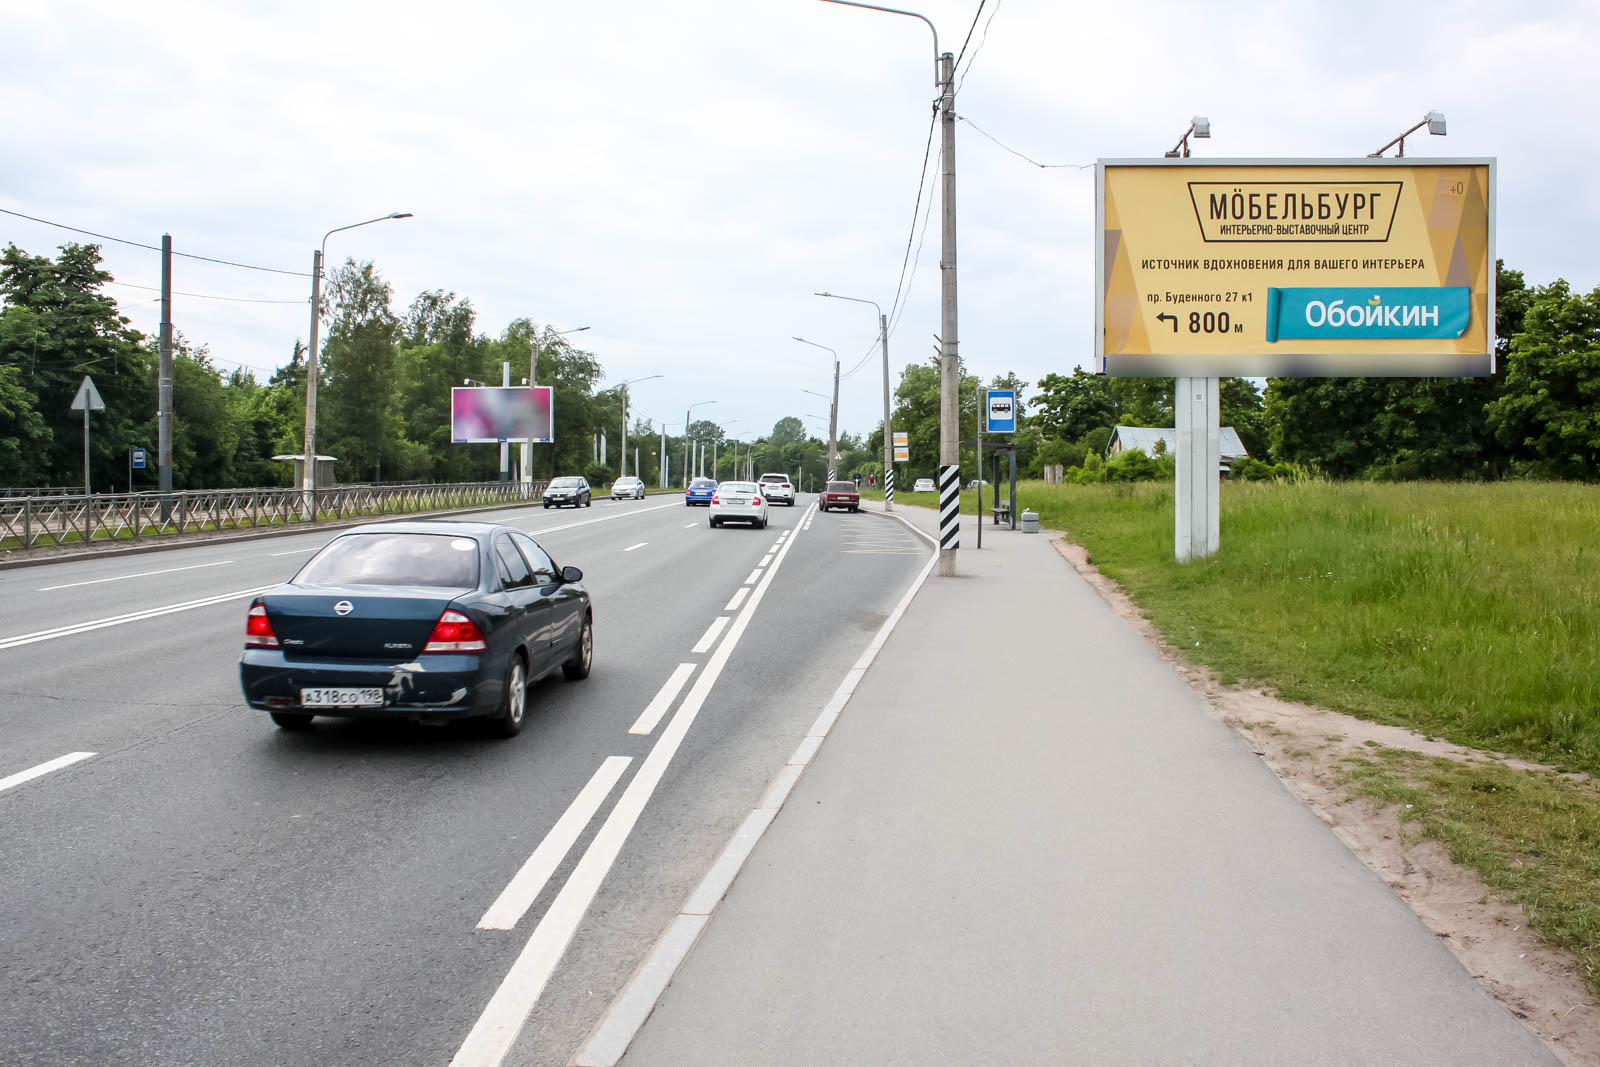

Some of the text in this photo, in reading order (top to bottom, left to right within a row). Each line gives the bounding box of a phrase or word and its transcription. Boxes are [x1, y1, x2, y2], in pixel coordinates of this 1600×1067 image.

[1220, 222, 1370, 236] ИНТЕРЬЕРНО-ВЫСТАВОЧНЫЙ ЦЕНТР
[1141, 258, 1425, 272] ИСТОЧНИК ВДОХНОВЕНИЯ ДЛЯ ВАШЕГО ИНТЕРЬЕРА
[1147, 292, 1253, 304] пр. Буденного 27 к1
[1305, 295, 1439, 327] Обойкин
[1188, 311, 1243, 334] 800 м
